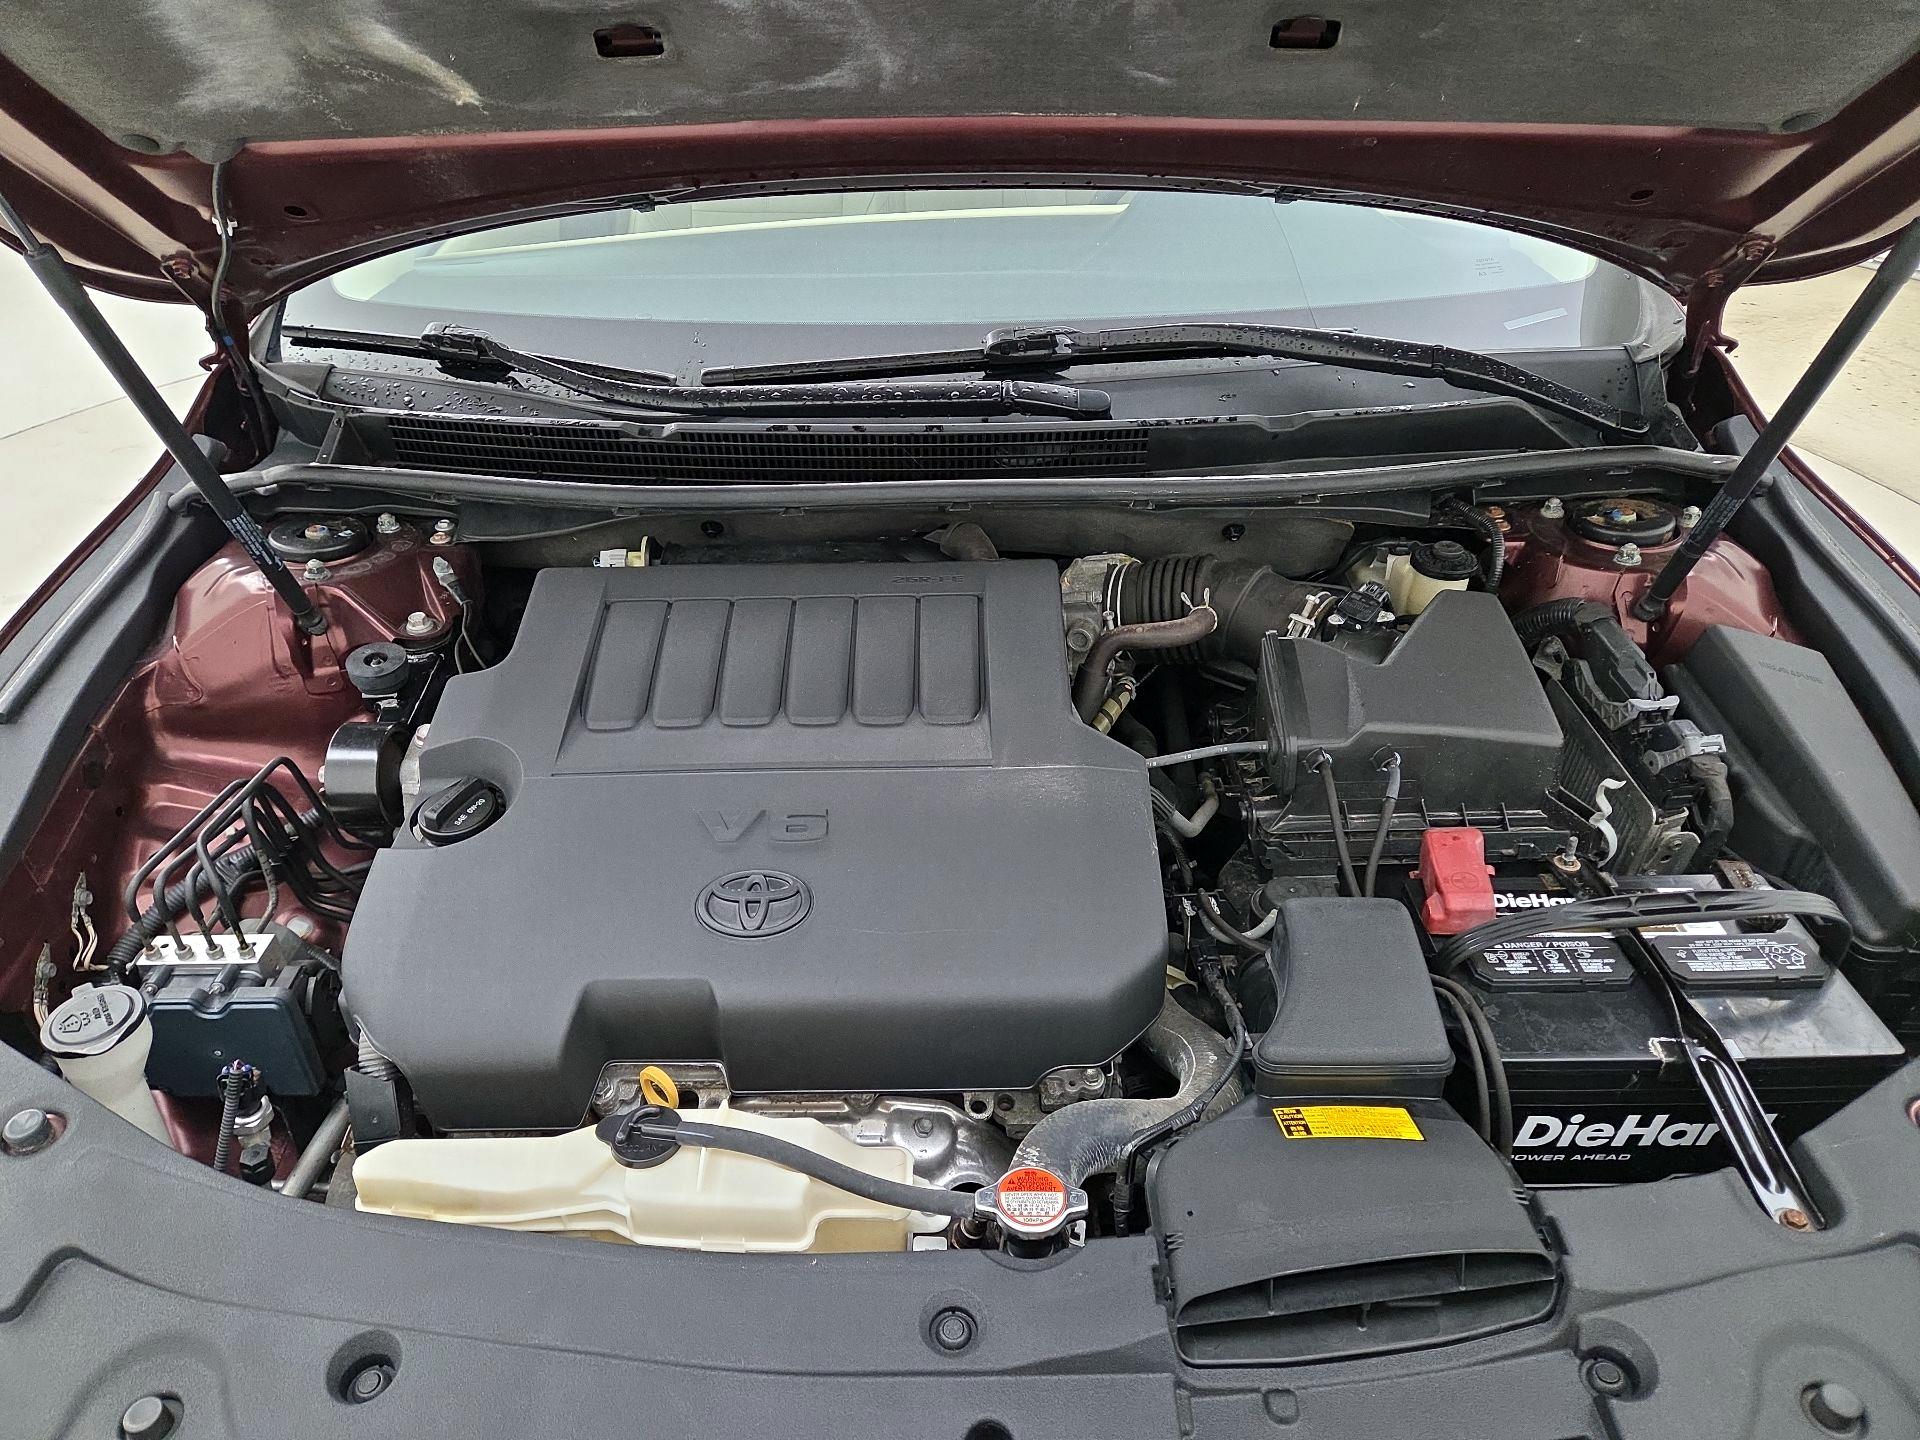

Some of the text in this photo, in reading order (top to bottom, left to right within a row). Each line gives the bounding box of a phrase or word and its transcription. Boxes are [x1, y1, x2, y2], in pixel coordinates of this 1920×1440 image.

[454, 813, 468, 826] SAE
[697, 809, 829, 843] V6
[1493, 892, 1577, 908] DieHar
[1502, 941, 1544, 949] DANGER
[1512, 1114, 1778, 1147] DieHar
[1570, 1153, 1631, 1161] AHEAD
